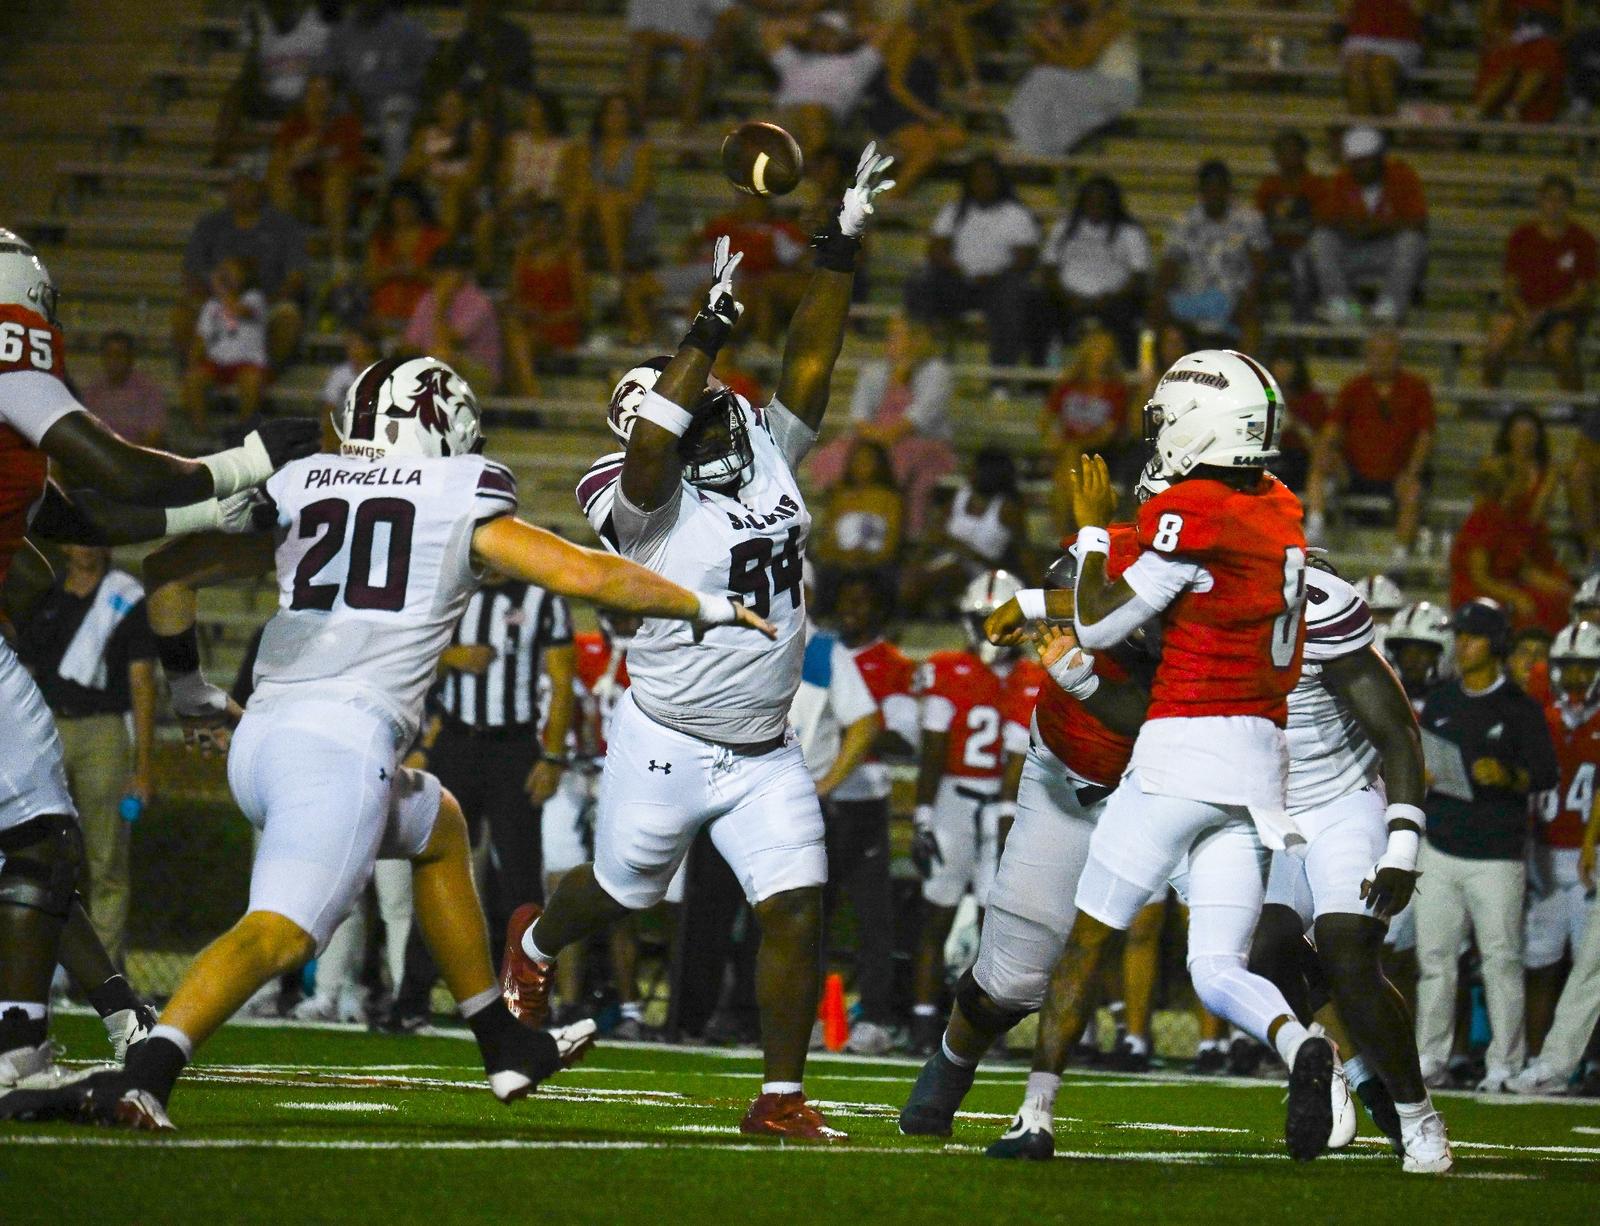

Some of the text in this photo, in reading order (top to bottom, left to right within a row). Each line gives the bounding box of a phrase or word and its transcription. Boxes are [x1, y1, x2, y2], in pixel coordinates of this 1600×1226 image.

[0, 321, 53, 370] 65
[341, 443, 386, 459] DAWGS
[304, 467, 422, 489] PARRELLA
[289, 497, 416, 612] 20
[1152, 513, 1184, 552] 8
[726, 524, 803, 619] 94
[963, 704, 1000, 769] 2
